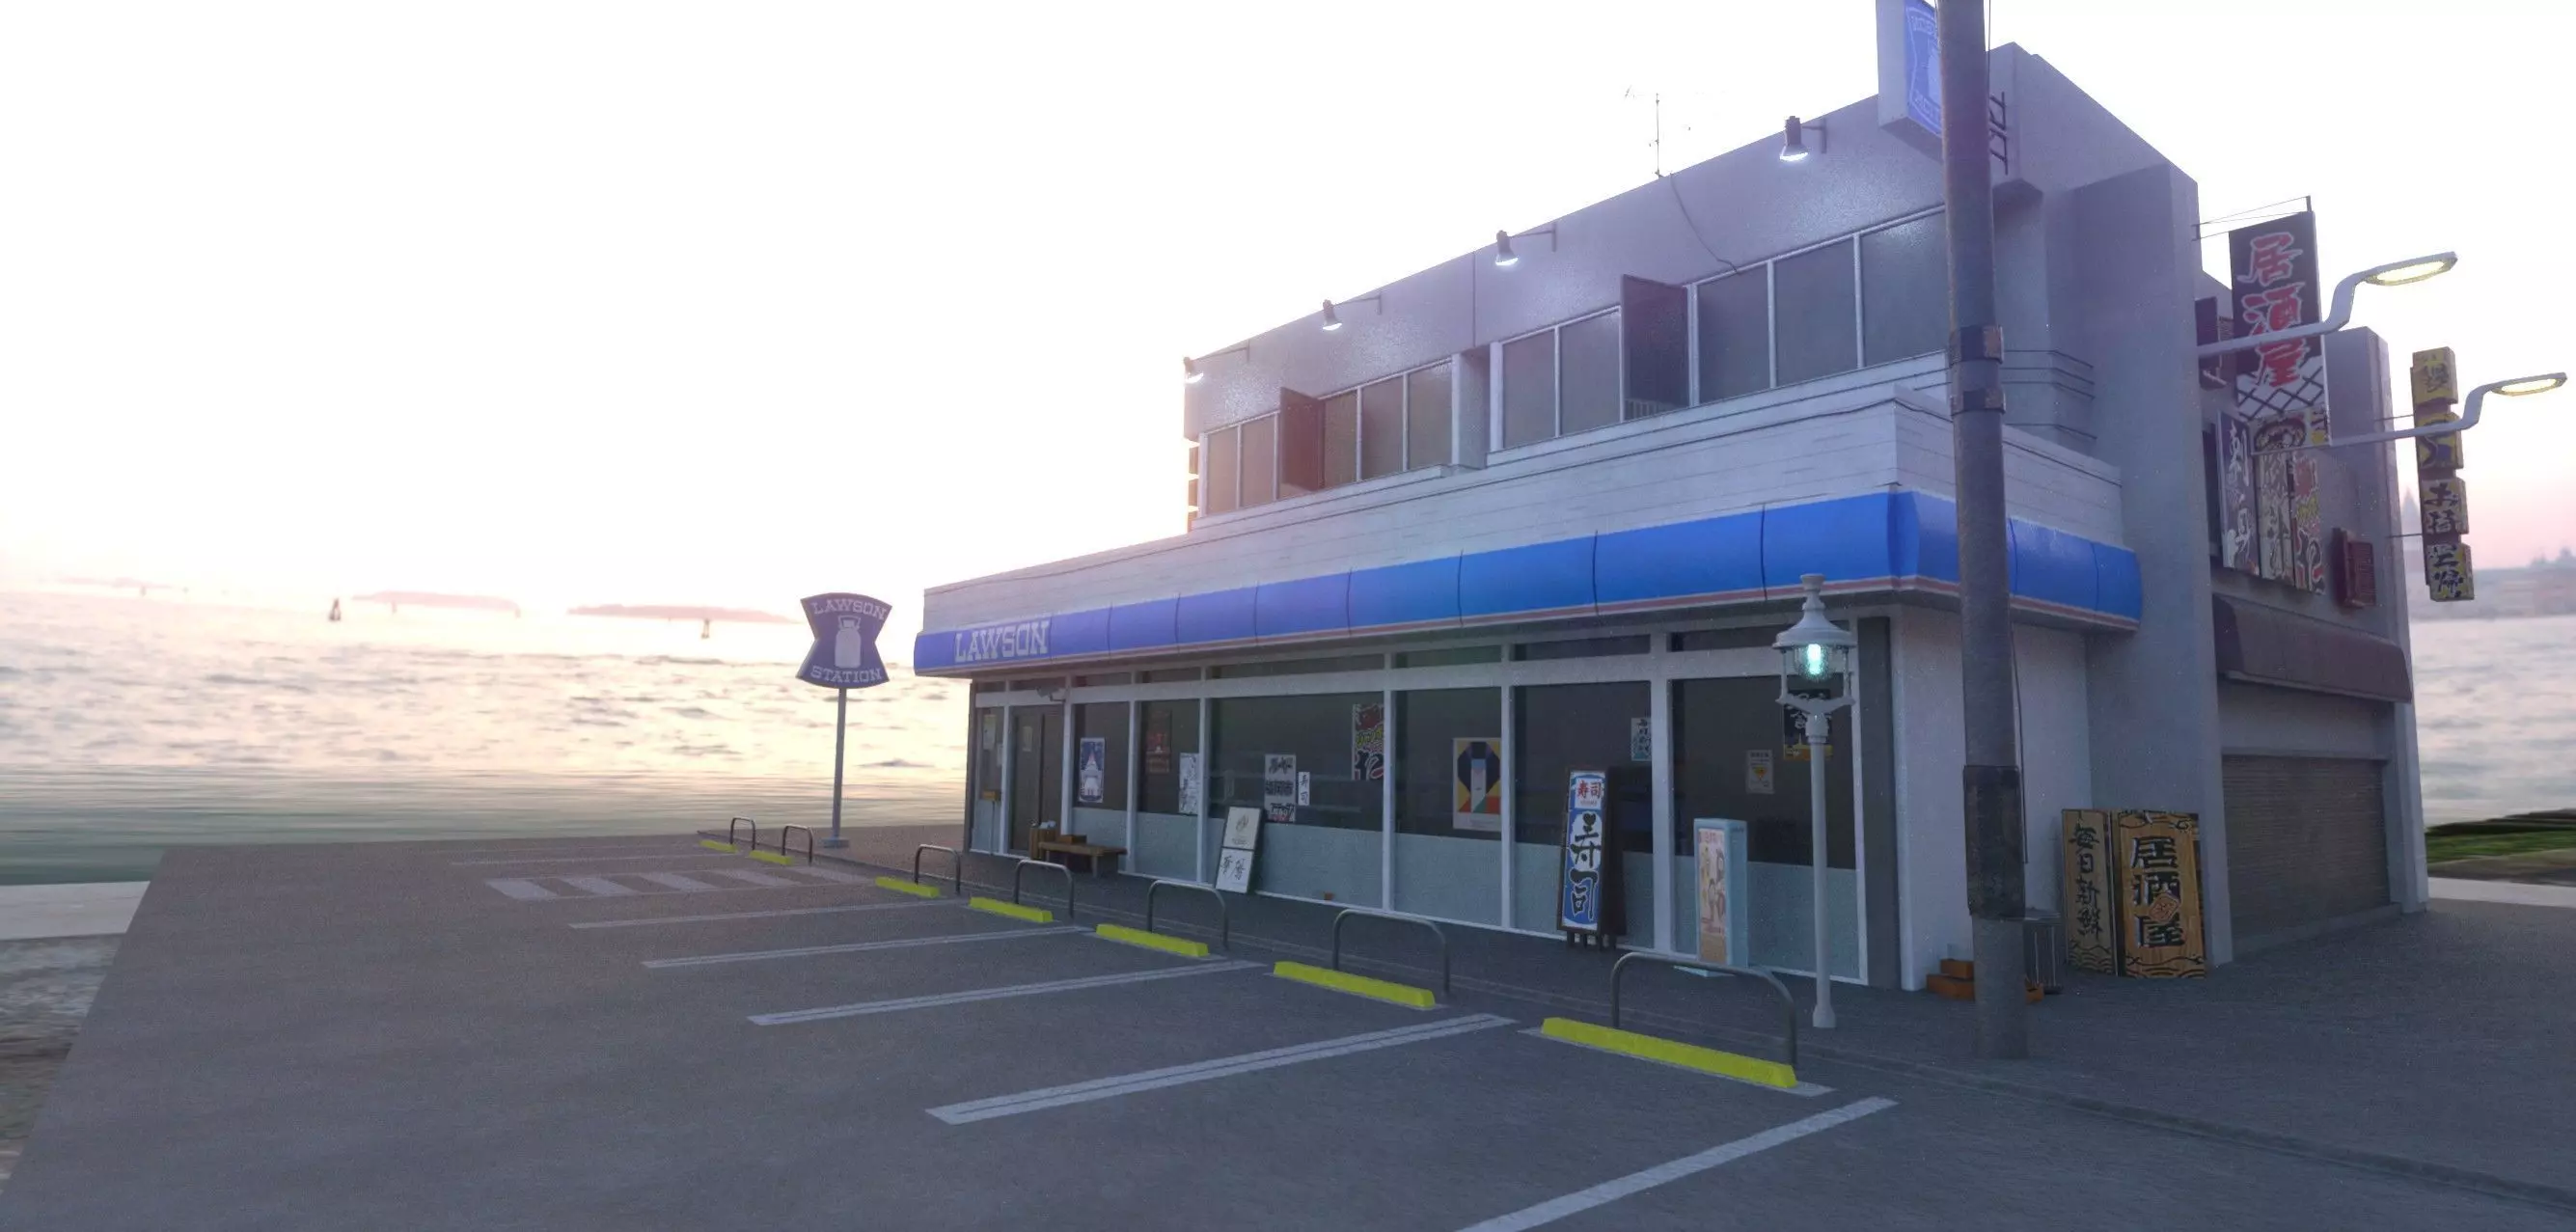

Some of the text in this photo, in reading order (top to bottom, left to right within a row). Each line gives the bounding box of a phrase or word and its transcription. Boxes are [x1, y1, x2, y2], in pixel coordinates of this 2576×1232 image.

[2235, 231, 2312, 388] 居酒屋
[810, 598, 887, 620] LAWSON
[954, 621, 1050, 662] LAWSON
[810, 665, 882, 683] STATION
[1577, 779, 1603, 800] 寿司
[1569, 810, 1602, 921] 寿司
[2130, 836, 2184, 947] 居酒屋
